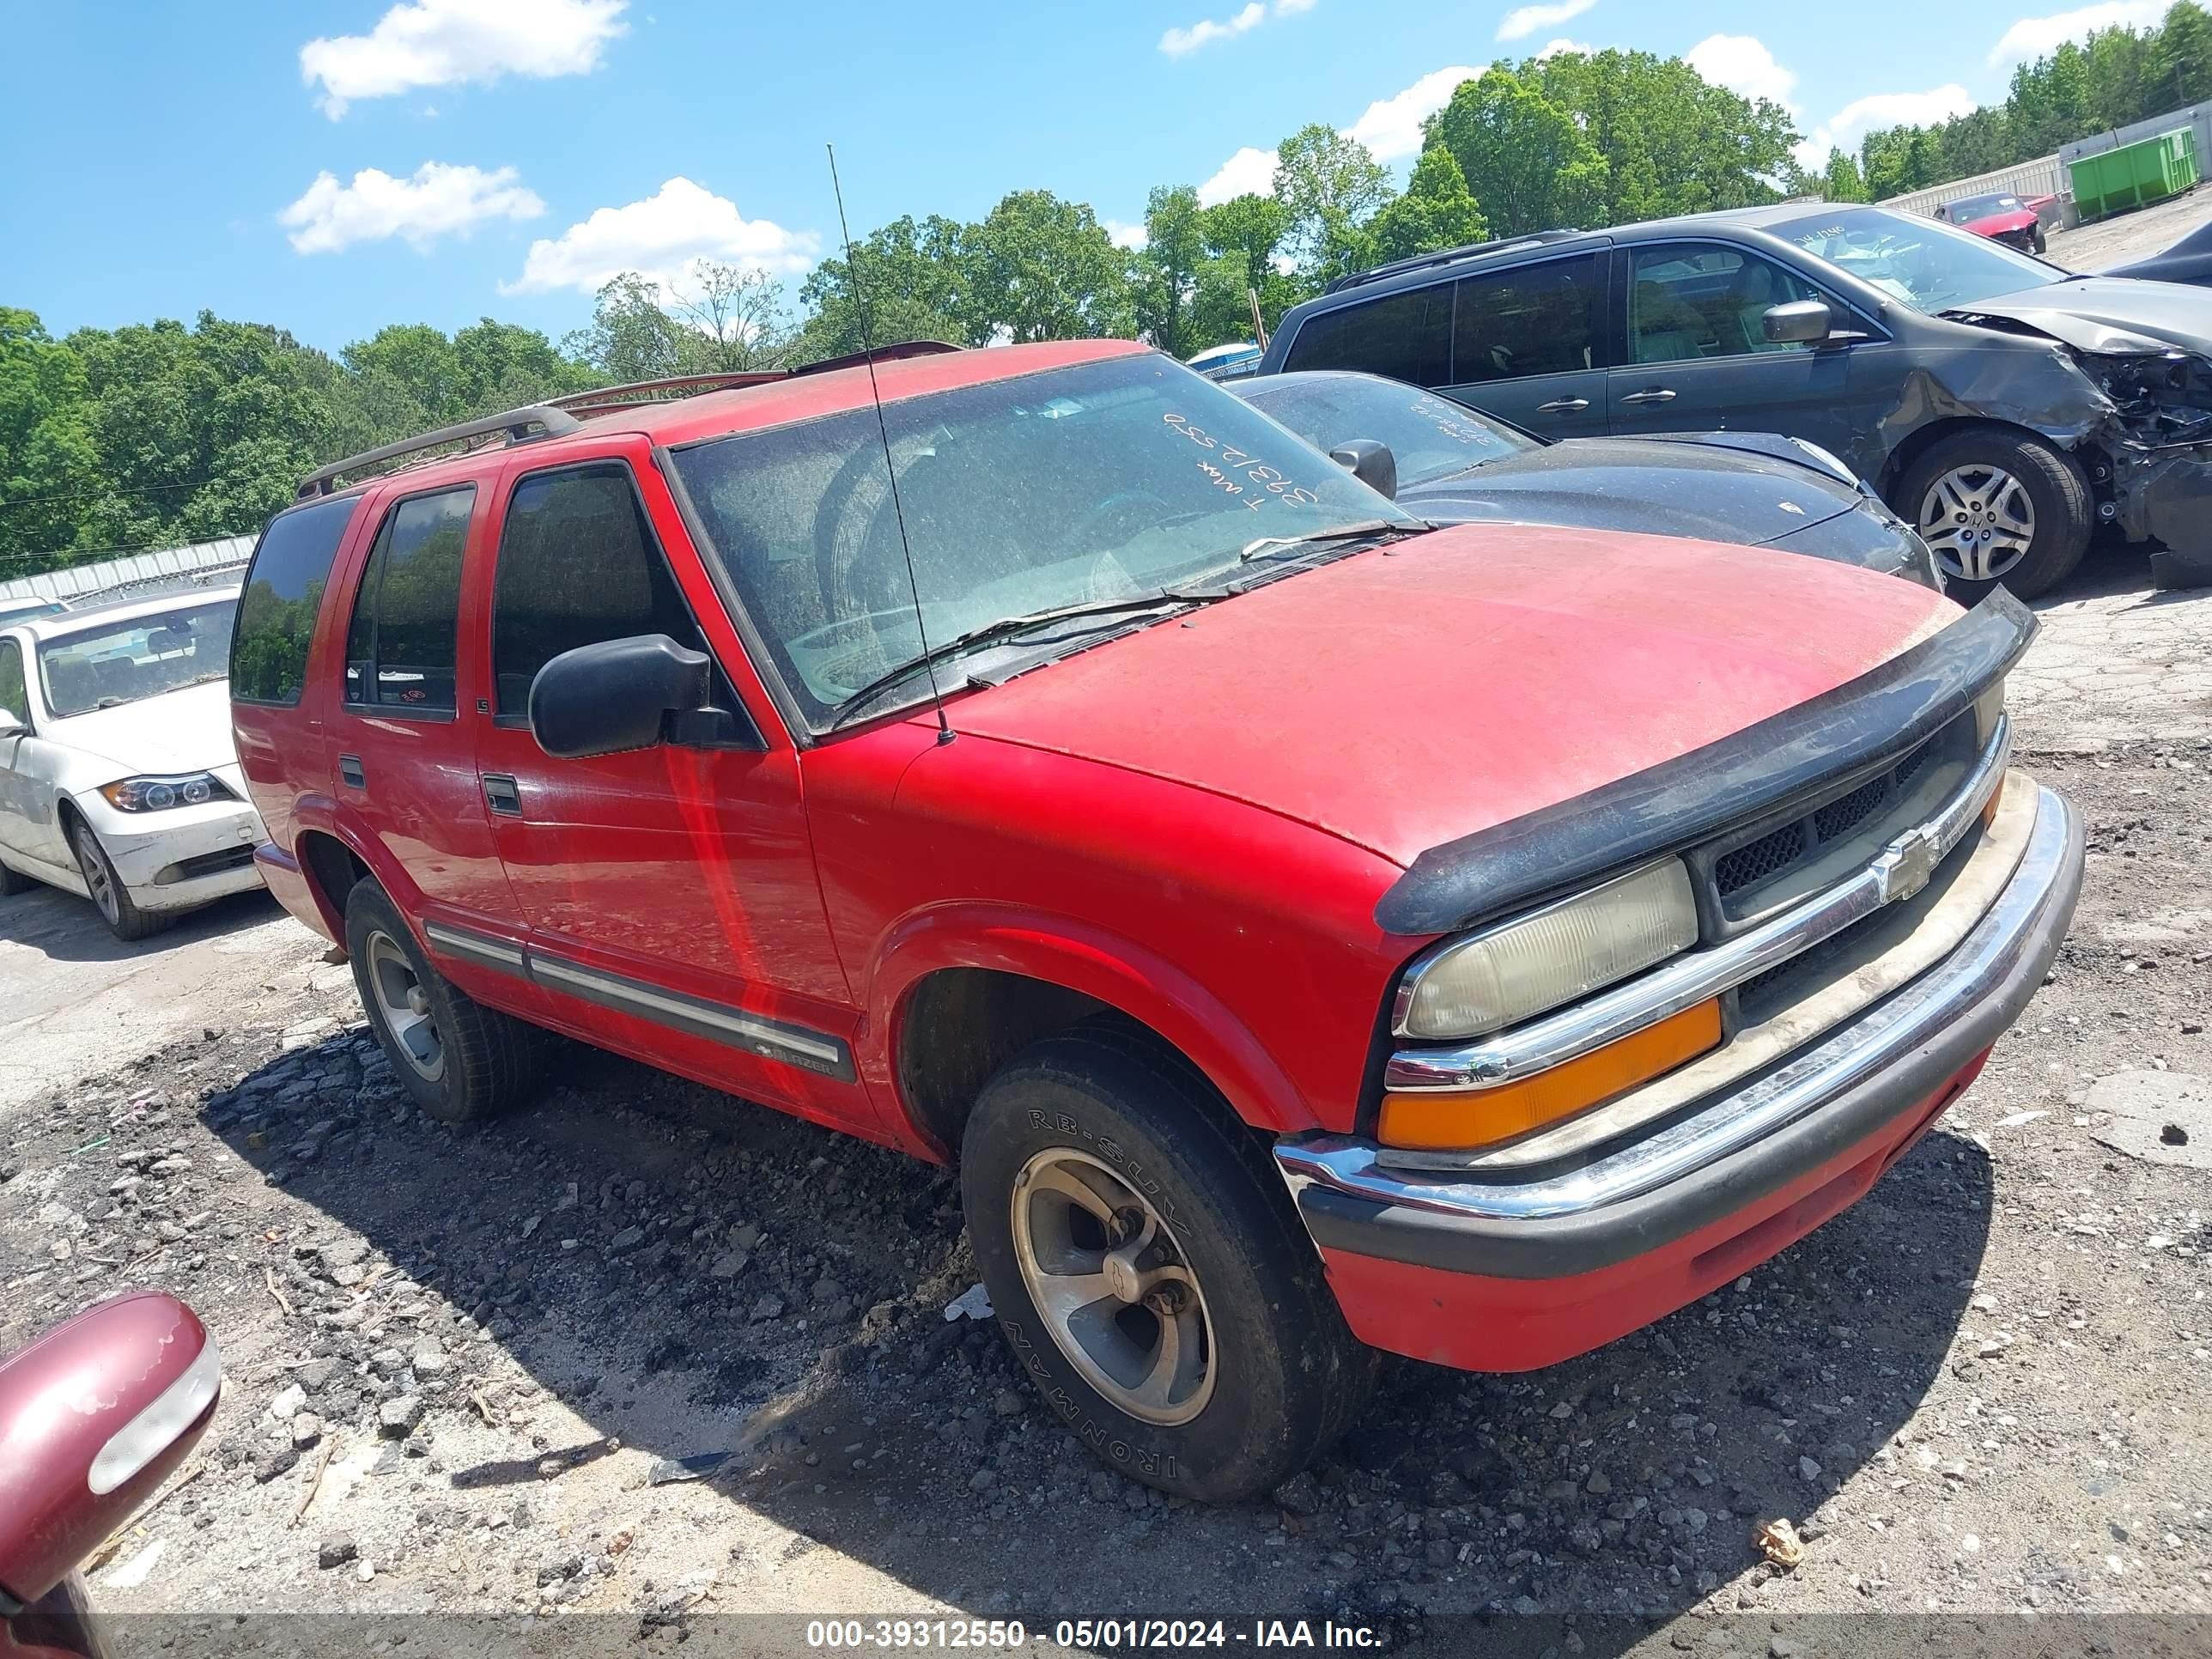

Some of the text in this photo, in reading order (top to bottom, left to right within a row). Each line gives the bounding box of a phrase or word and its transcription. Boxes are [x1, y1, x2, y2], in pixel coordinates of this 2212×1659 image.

[1163, 413, 1319, 509] 39312550
[476, 699, 489, 712] LS
[773, 1048, 835, 1077] BLAZER
